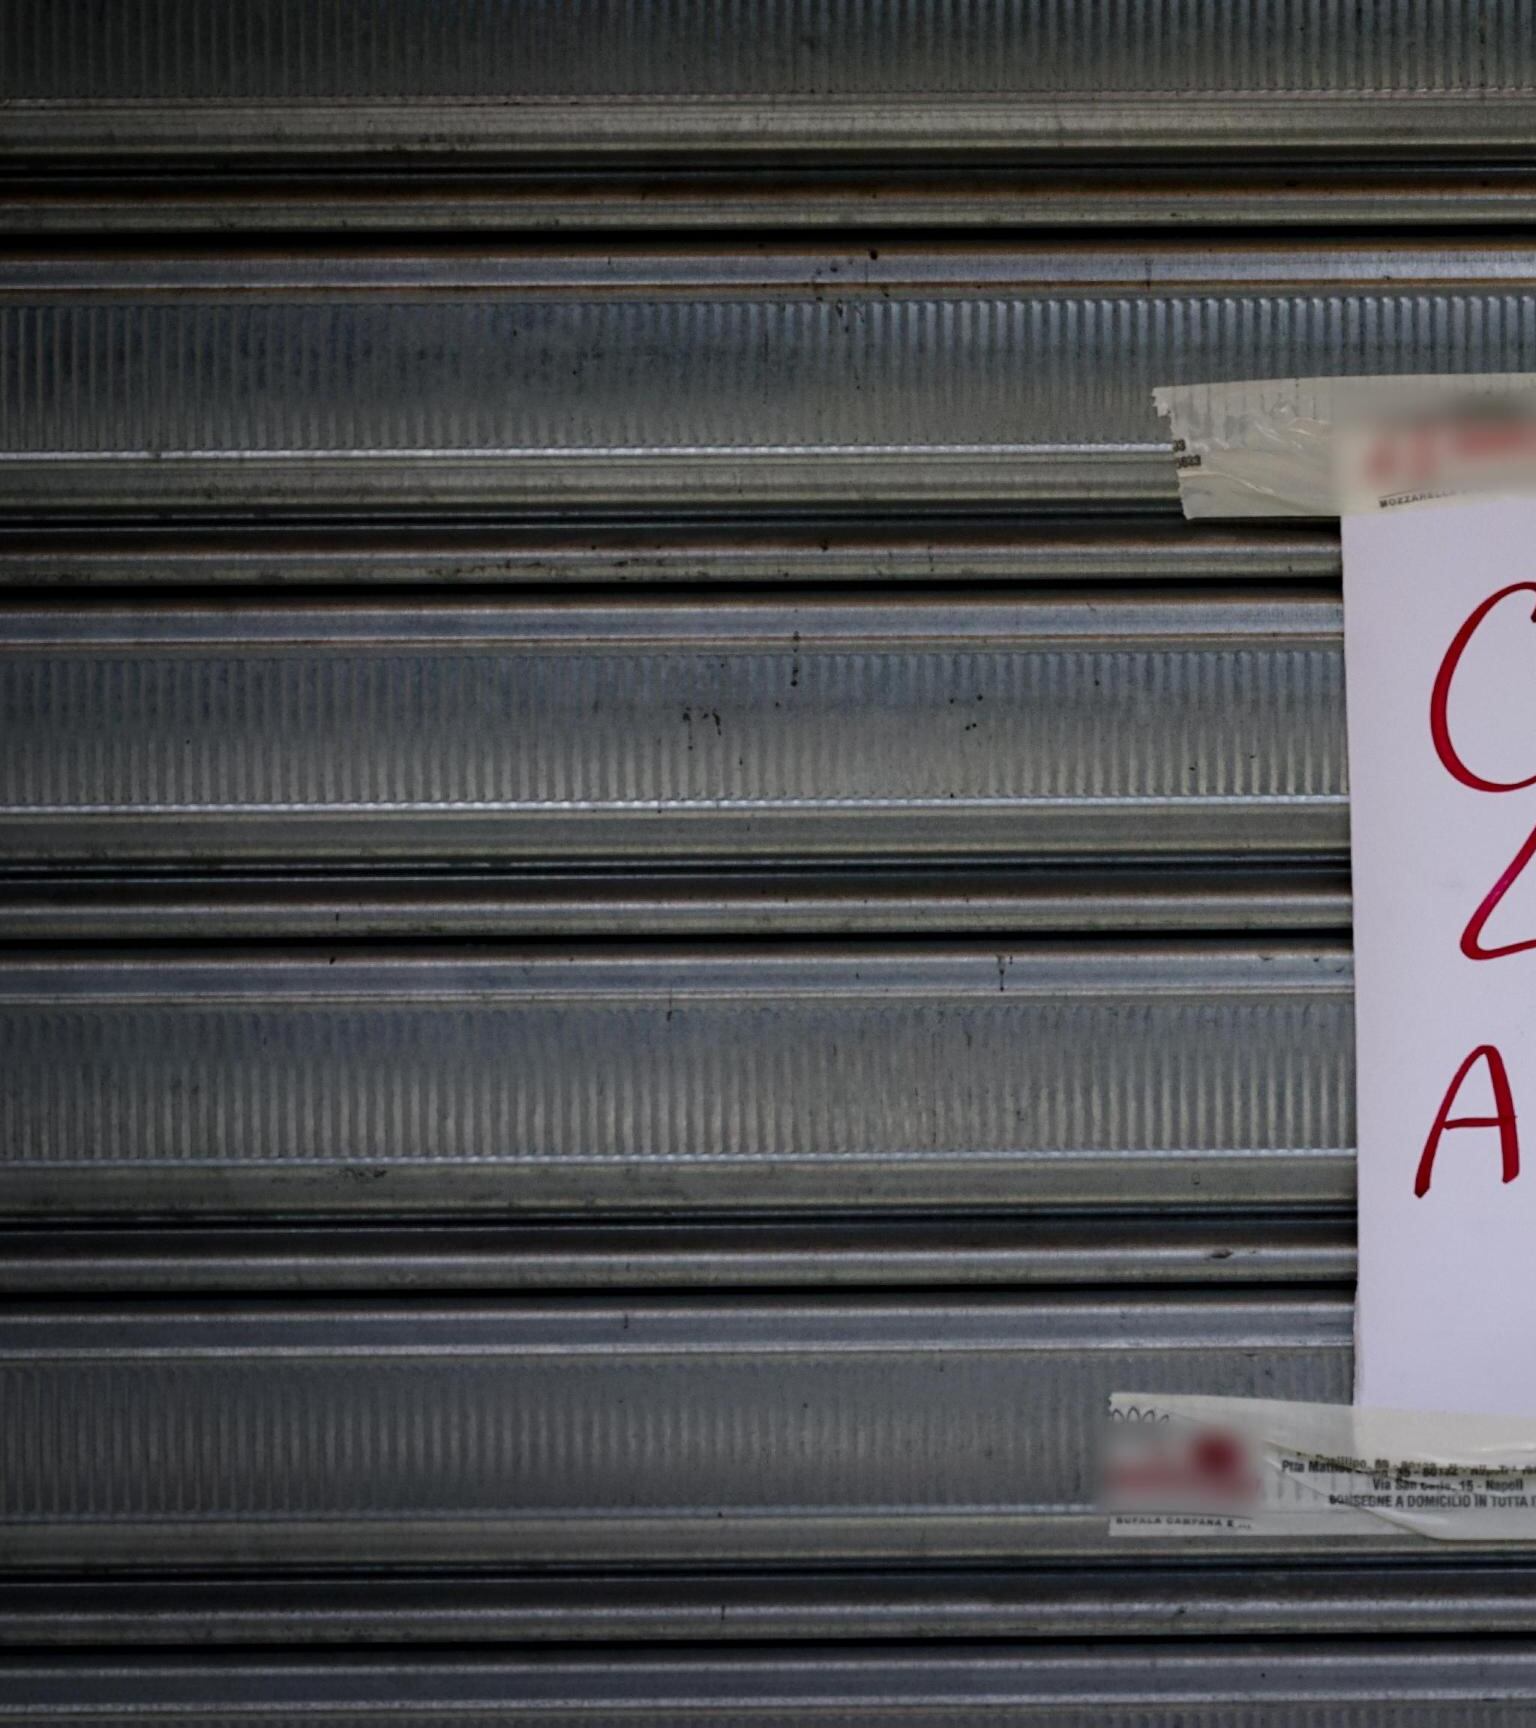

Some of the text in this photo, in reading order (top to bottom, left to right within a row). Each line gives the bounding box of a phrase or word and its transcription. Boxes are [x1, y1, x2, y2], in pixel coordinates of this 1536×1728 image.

[1373, 1478, 1391, 1491] Via
[1486, 1478, 1523, 1492] Napoli
[1395, 1495, 1404, 1507] A
[1407, 1494, 1471, 1508] DOMICILIO
[1475, 1494, 1487, 1507] IN
[1491, 1495, 1528, 1508] TUTTA
